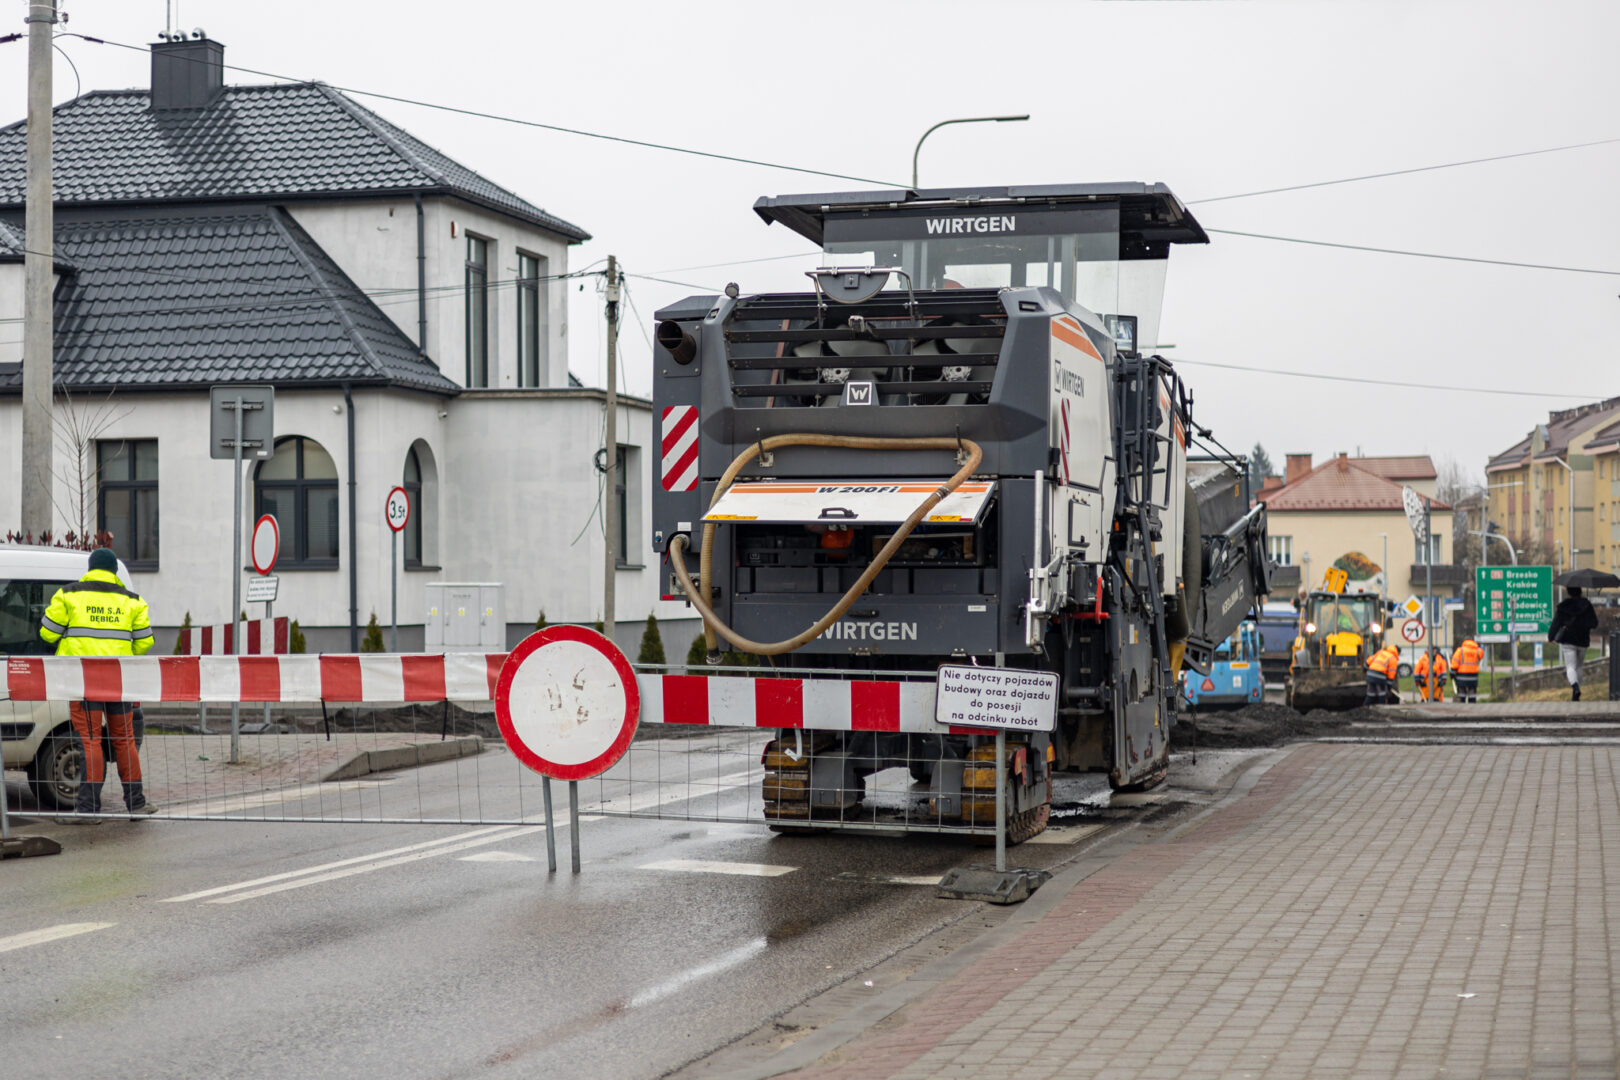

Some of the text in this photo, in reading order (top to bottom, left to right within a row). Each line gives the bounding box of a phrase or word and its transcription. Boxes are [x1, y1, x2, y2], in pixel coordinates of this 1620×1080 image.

[926, 216, 1015, 234] WIRTGEN
[1062, 368, 1085, 398] WIRTGEN
[390, 500, 405, 519] 3,5t
[1506, 570, 1538, 578] Brzesko
[1506, 580, 1537, 588] Kraków
[1506, 590, 1538, 599] Krynica
[86, 606, 124, 615] PDM S.A.
[1507, 611, 1542, 620] Pzemyśl
[90, 615, 120, 623] DĘBICA
[944, 670, 1053, 687] Nie dotyczy pojazdów
[944, 683, 1050, 701] budowy oraz dojazdu
[970, 699, 1022, 713] do posesji
[952, 712, 1038, 726] na odcinku robót
